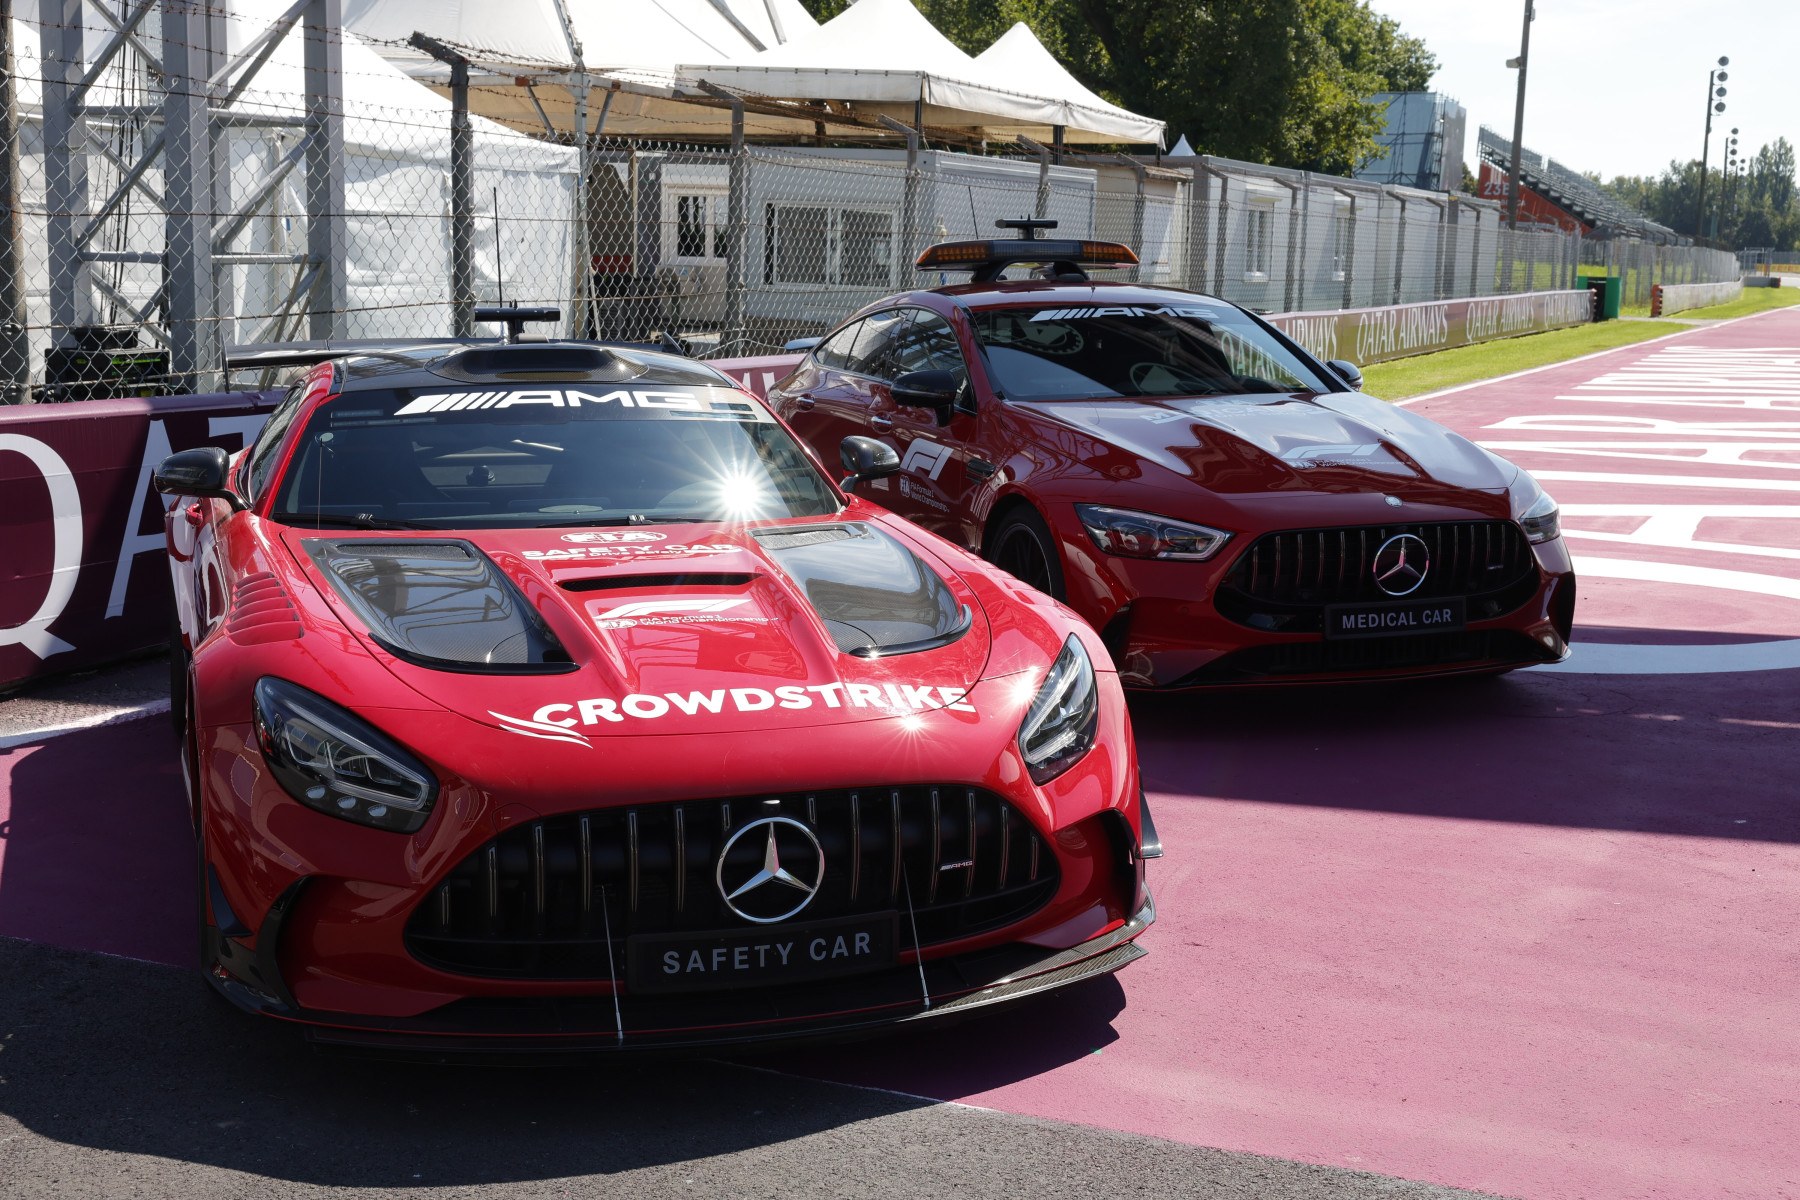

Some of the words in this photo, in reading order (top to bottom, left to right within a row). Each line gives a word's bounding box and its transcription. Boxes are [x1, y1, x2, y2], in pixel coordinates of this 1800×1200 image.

[1092, 306, 1220, 319] AMG
[1466, 299, 1497, 342] QATAR
[1500, 296, 1535, 333] AIRWAYS
[1356, 310, 1397, 363] QATAR
[1398, 304, 1448, 350] AIRWAYS
[494, 390, 703, 410] AMG
[521, 545, 652, 557] SAFETY
[664, 544, 738, 552] CAR
[1342, 611, 1417, 629] MEDICAL
[1422, 608, 1452, 624] CAR
[532, 681, 978, 729] CROWDSTRIKE
[662, 941, 794, 974] SAFETY
[809, 932, 871, 961] CAR
